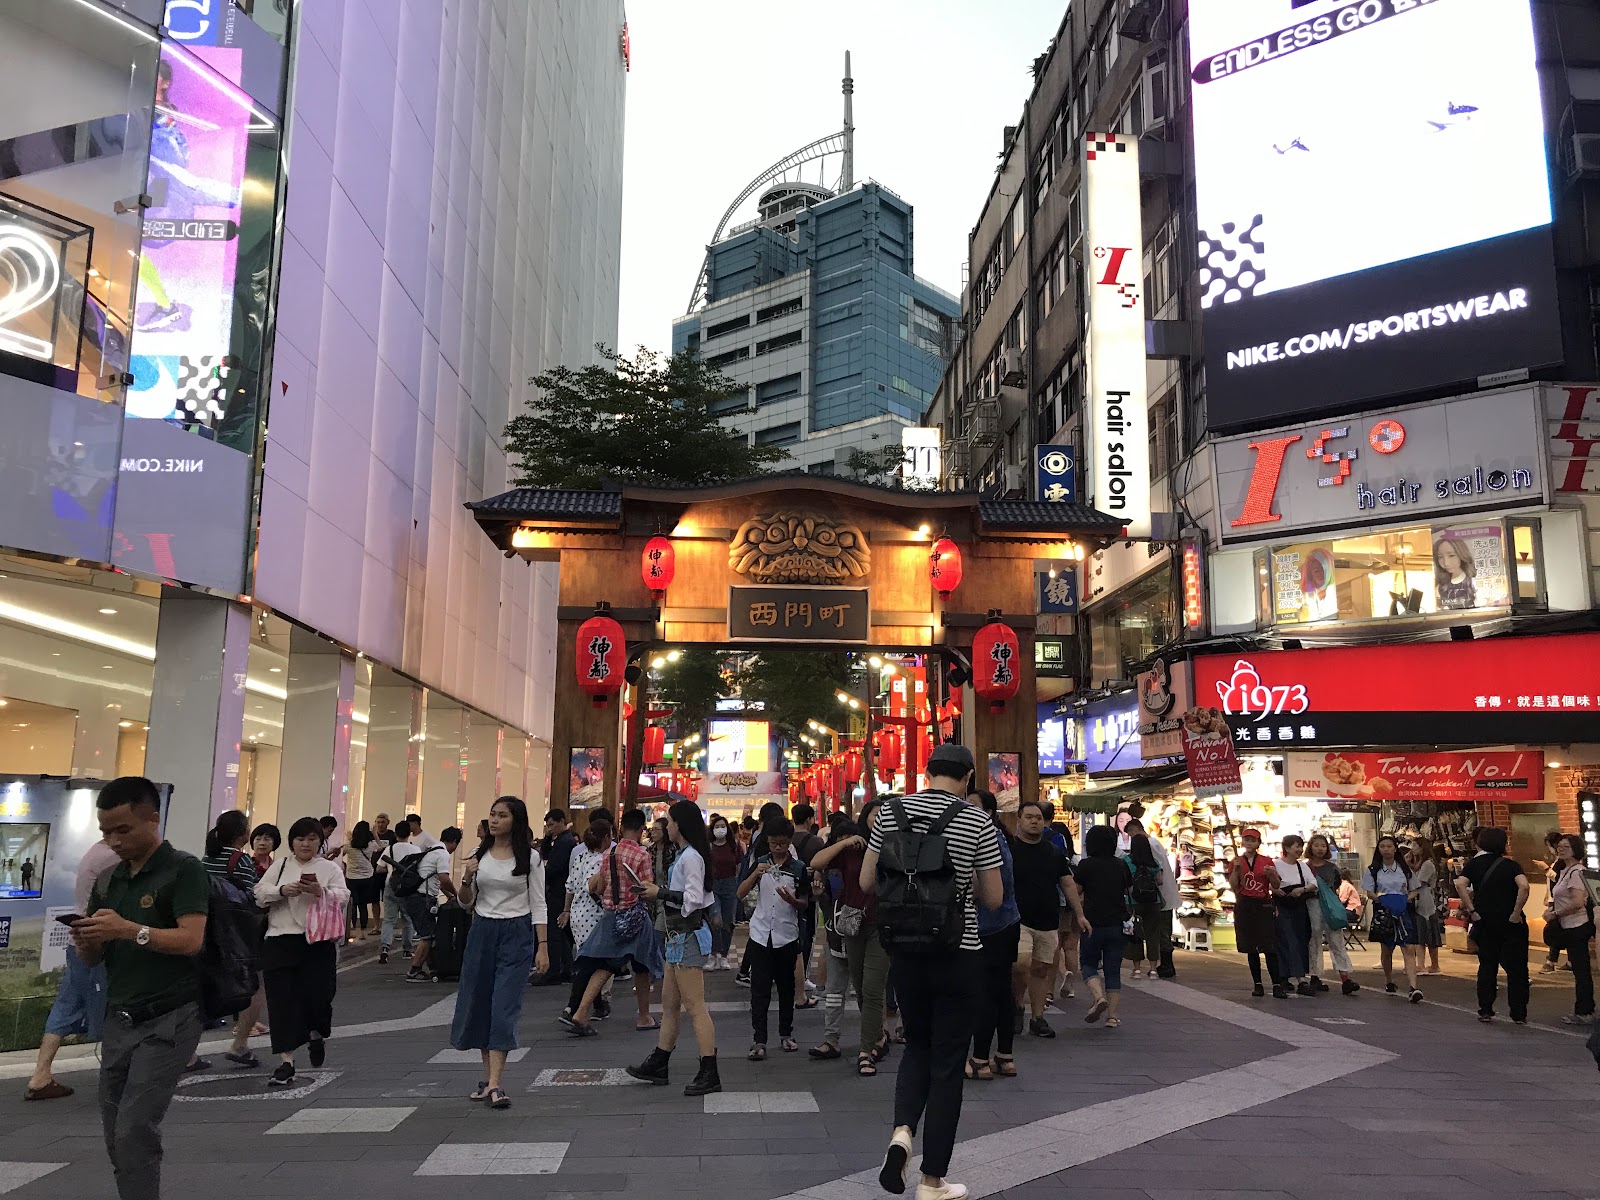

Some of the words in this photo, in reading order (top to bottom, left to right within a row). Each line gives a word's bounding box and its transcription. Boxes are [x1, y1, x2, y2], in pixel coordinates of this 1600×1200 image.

[1210, 17, 1332, 80] ENDLESS
[1336, 1, 1382, 32] GO
[1226, 288, 1528, 370] NIKE.COM/SPORTSWEAR
[1105, 390, 1132, 436] hair
[1107, 442, 1133, 510] salon
[1357, 479, 1420, 509] hair
[1434, 467, 1532, 499] salon
[1044, 577, 1074, 607] 鏡
[749, 601, 851, 628] 西門町
[588, 636, 613, 680] 神都
[990, 642, 1013, 686] 神都
[1239, 683, 1310, 723] 1973
[1185, 738, 1228, 751] Taiwan
[1377, 756, 1452, 775] Taiwan
[1458, 753, 1524, 777] No.1
[1294, 780, 1321, 788] CNN
[1396, 778, 1424, 787] Fried
[1426, 778, 1471, 788] chicken!!
